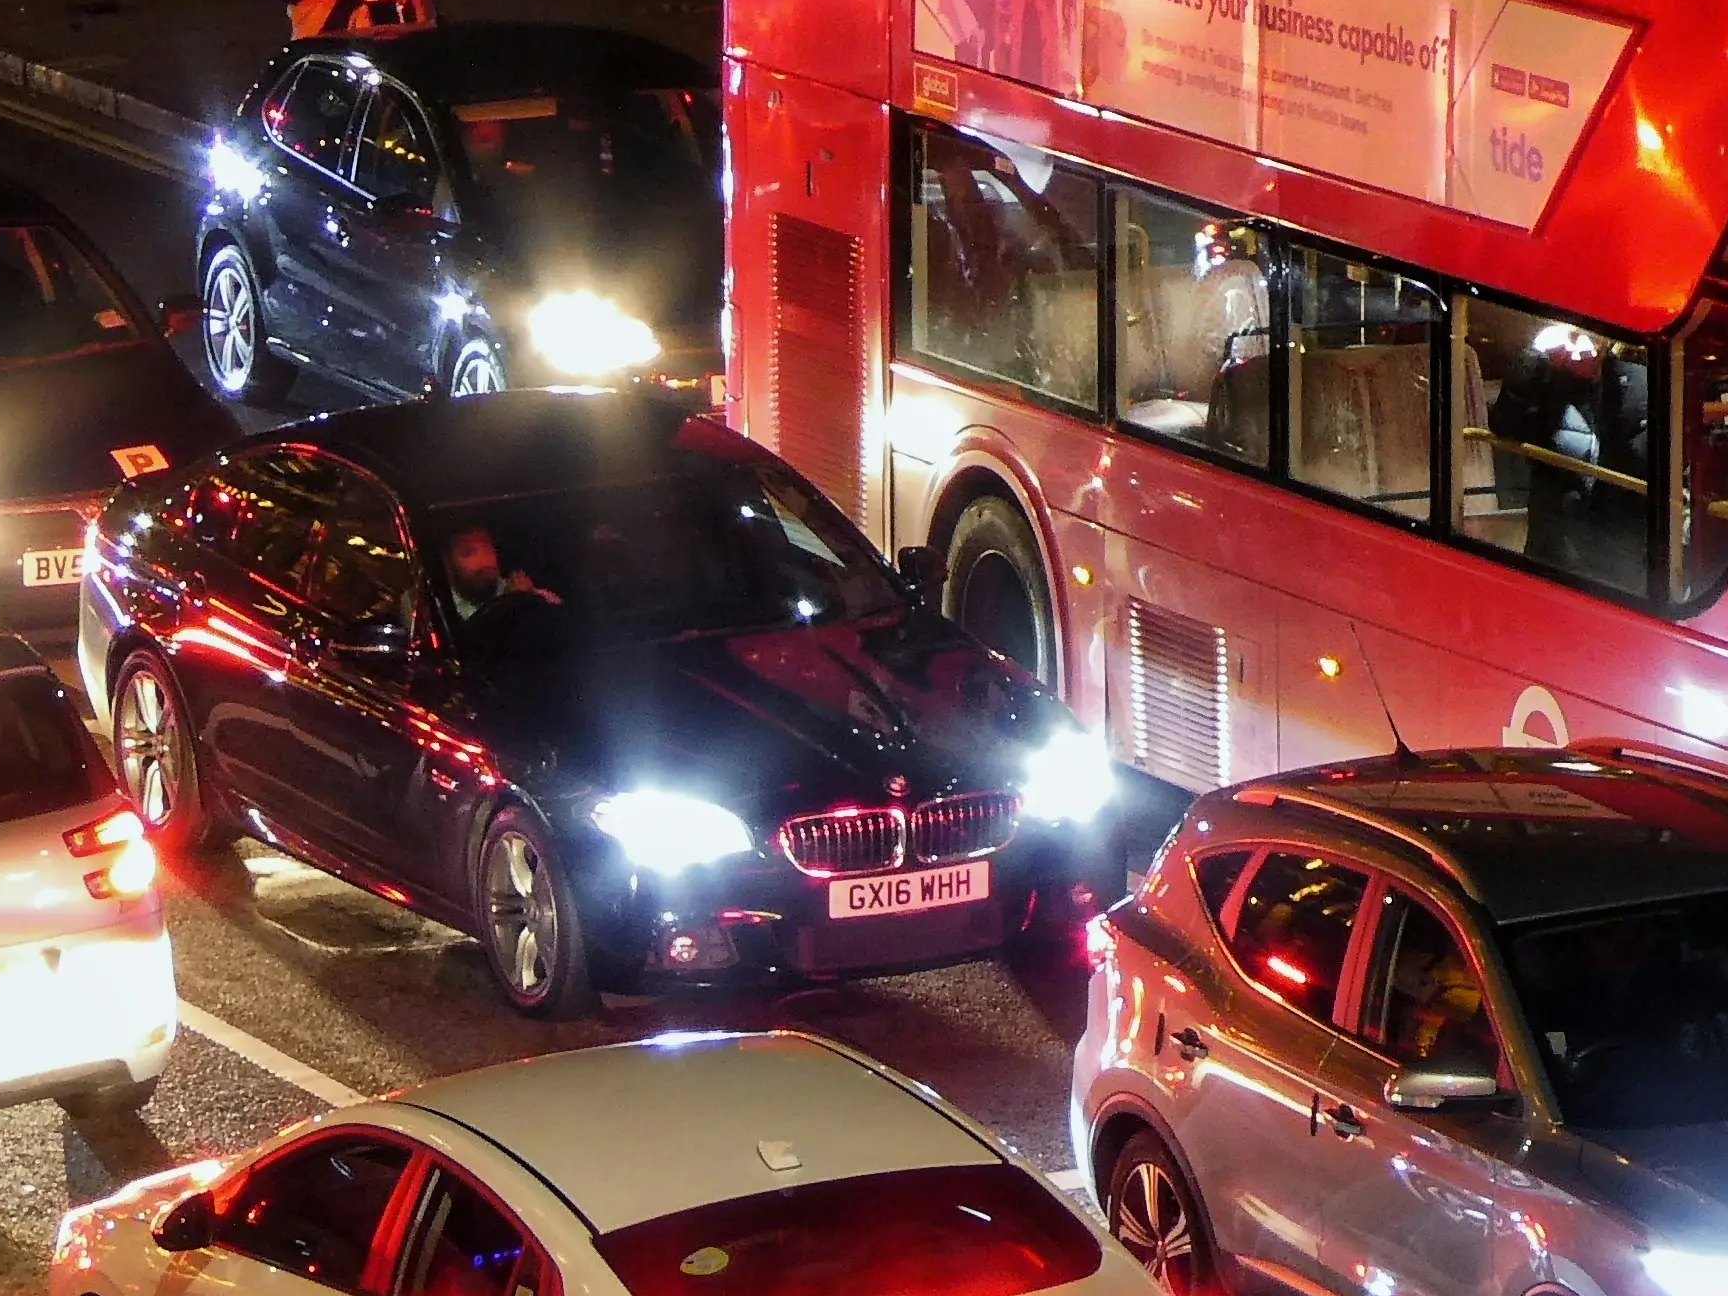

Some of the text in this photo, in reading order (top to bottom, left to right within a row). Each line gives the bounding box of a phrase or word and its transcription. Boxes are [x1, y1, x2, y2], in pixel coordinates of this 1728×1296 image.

[1338, 21, 1415, 66] capable
[1489, 126, 1544, 182] tide
[126, 453, 155, 475] P
[849, 869, 971, 910] GX16 WHH
